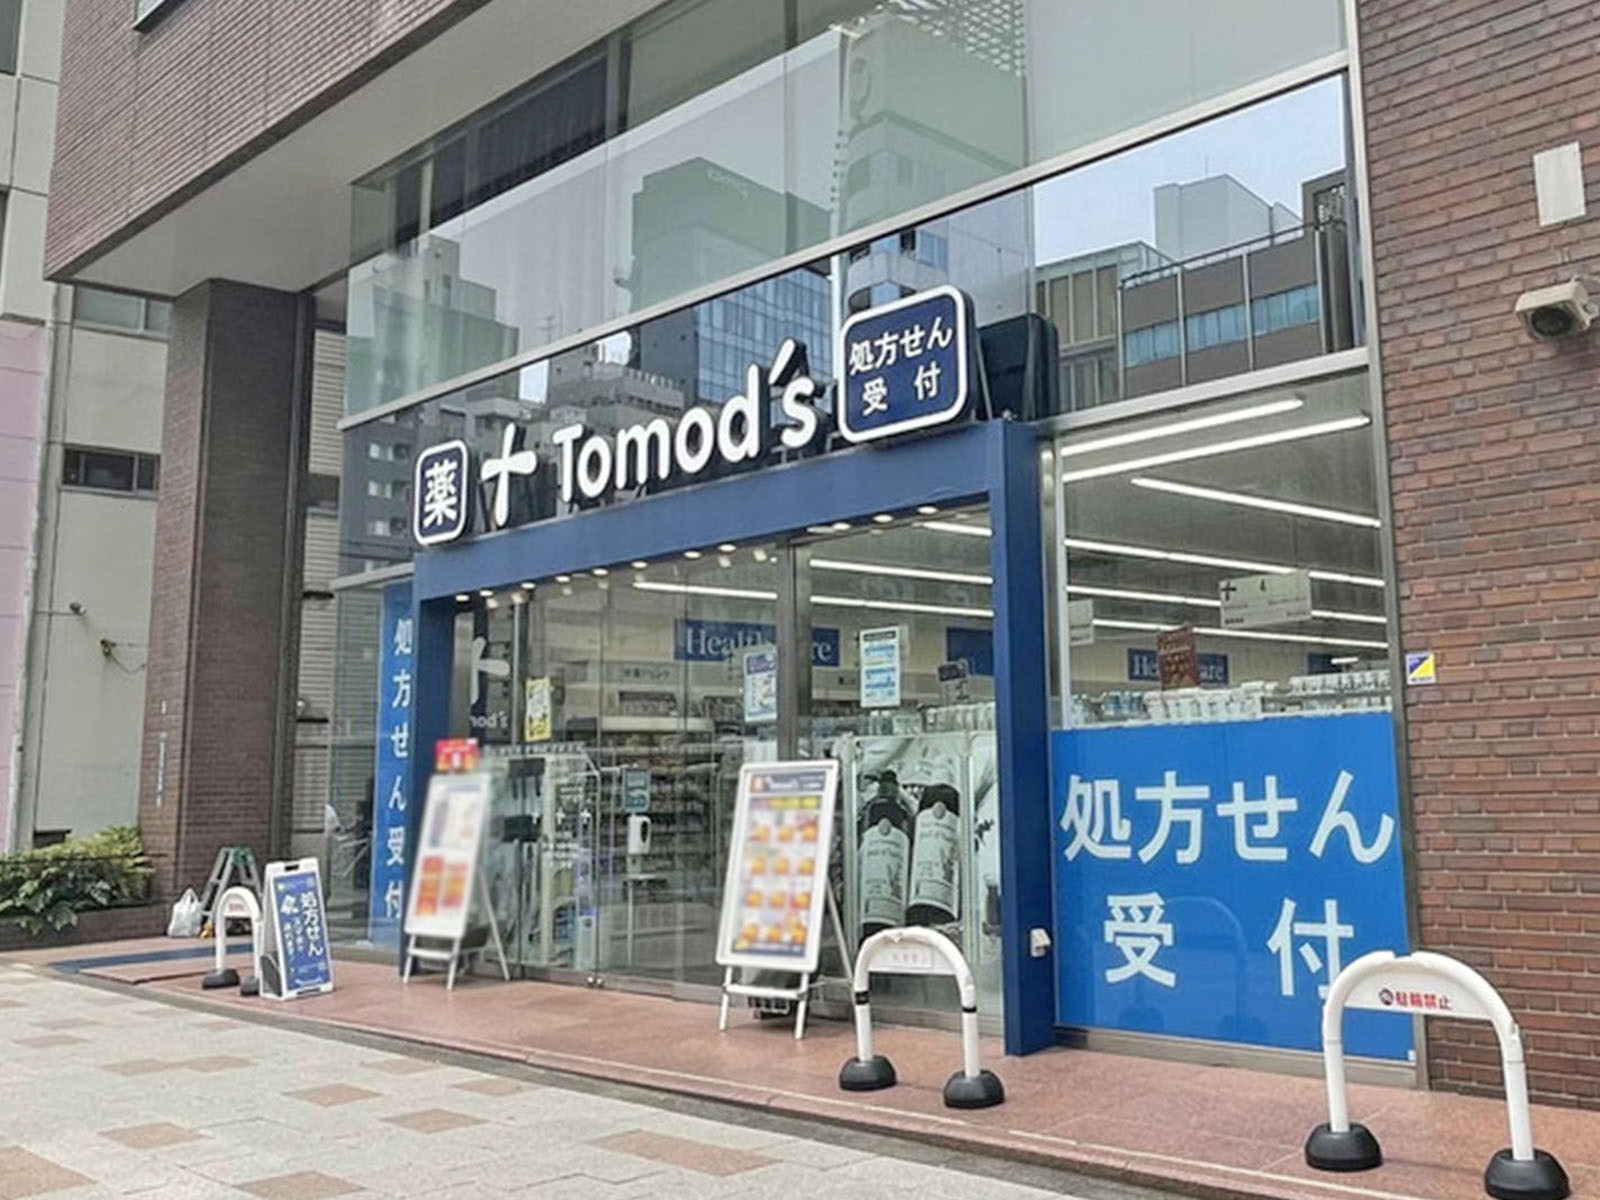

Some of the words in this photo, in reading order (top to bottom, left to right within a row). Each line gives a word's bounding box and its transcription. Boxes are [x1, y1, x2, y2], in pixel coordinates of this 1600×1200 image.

[848, 315, 953, 376] 処方せん
[553, 339, 818, 504] Tomod's
[422, 460, 459, 528] 薬
[384, 618, 414, 919] 処方せん受付
[1060, 769, 1396, 865] 処方せん
[300, 890, 324, 957] 処方せん
